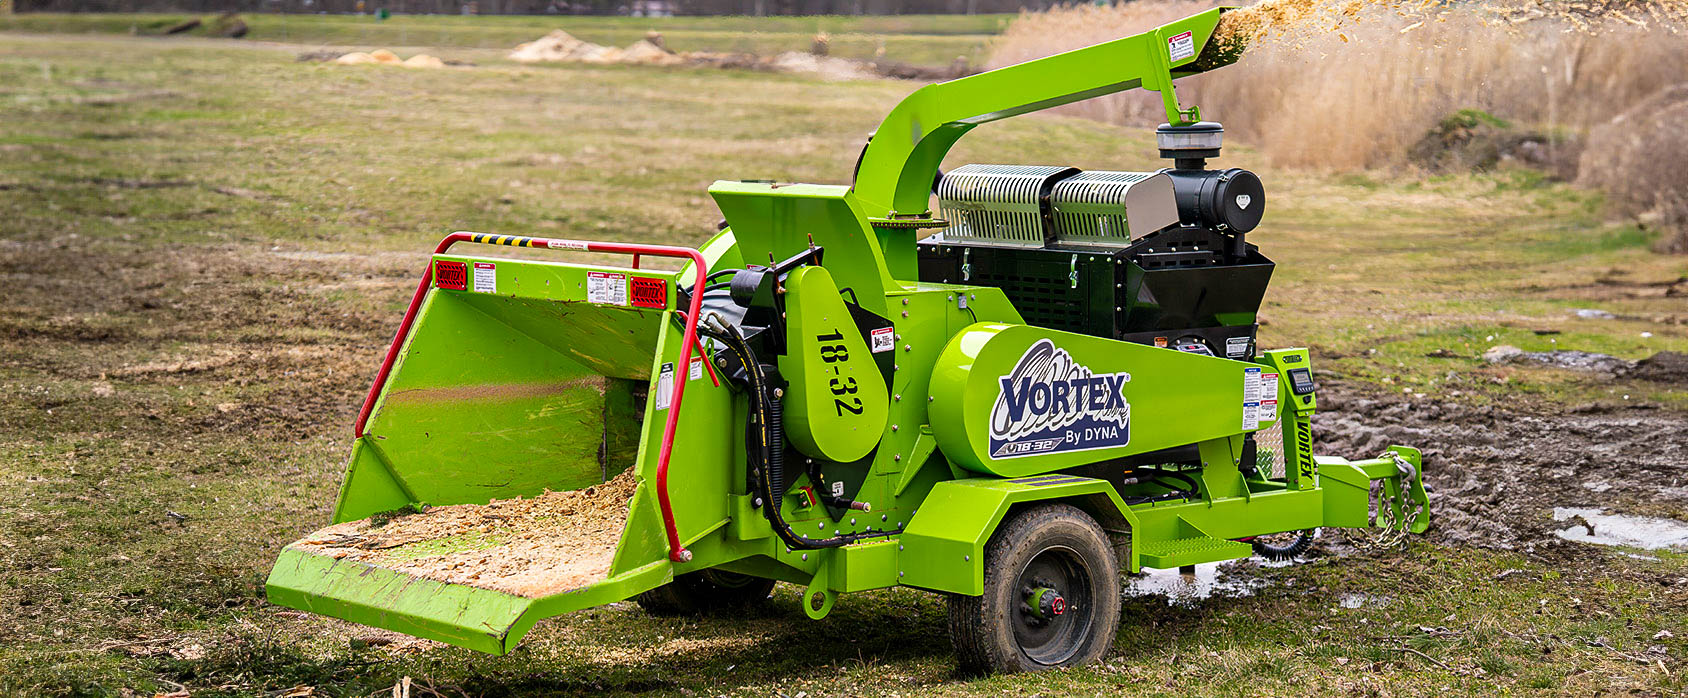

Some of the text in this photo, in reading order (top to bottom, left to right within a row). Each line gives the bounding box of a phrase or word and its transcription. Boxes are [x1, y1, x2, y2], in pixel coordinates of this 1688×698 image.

[635, 286, 660, 299] VORTEX
[817, 328, 863, 416] 18-32
[1001, 375, 1125, 423] VORTEX
[1066, 426, 1119, 445] By DYNA
[1297, 421, 1313, 480] VORTEX
